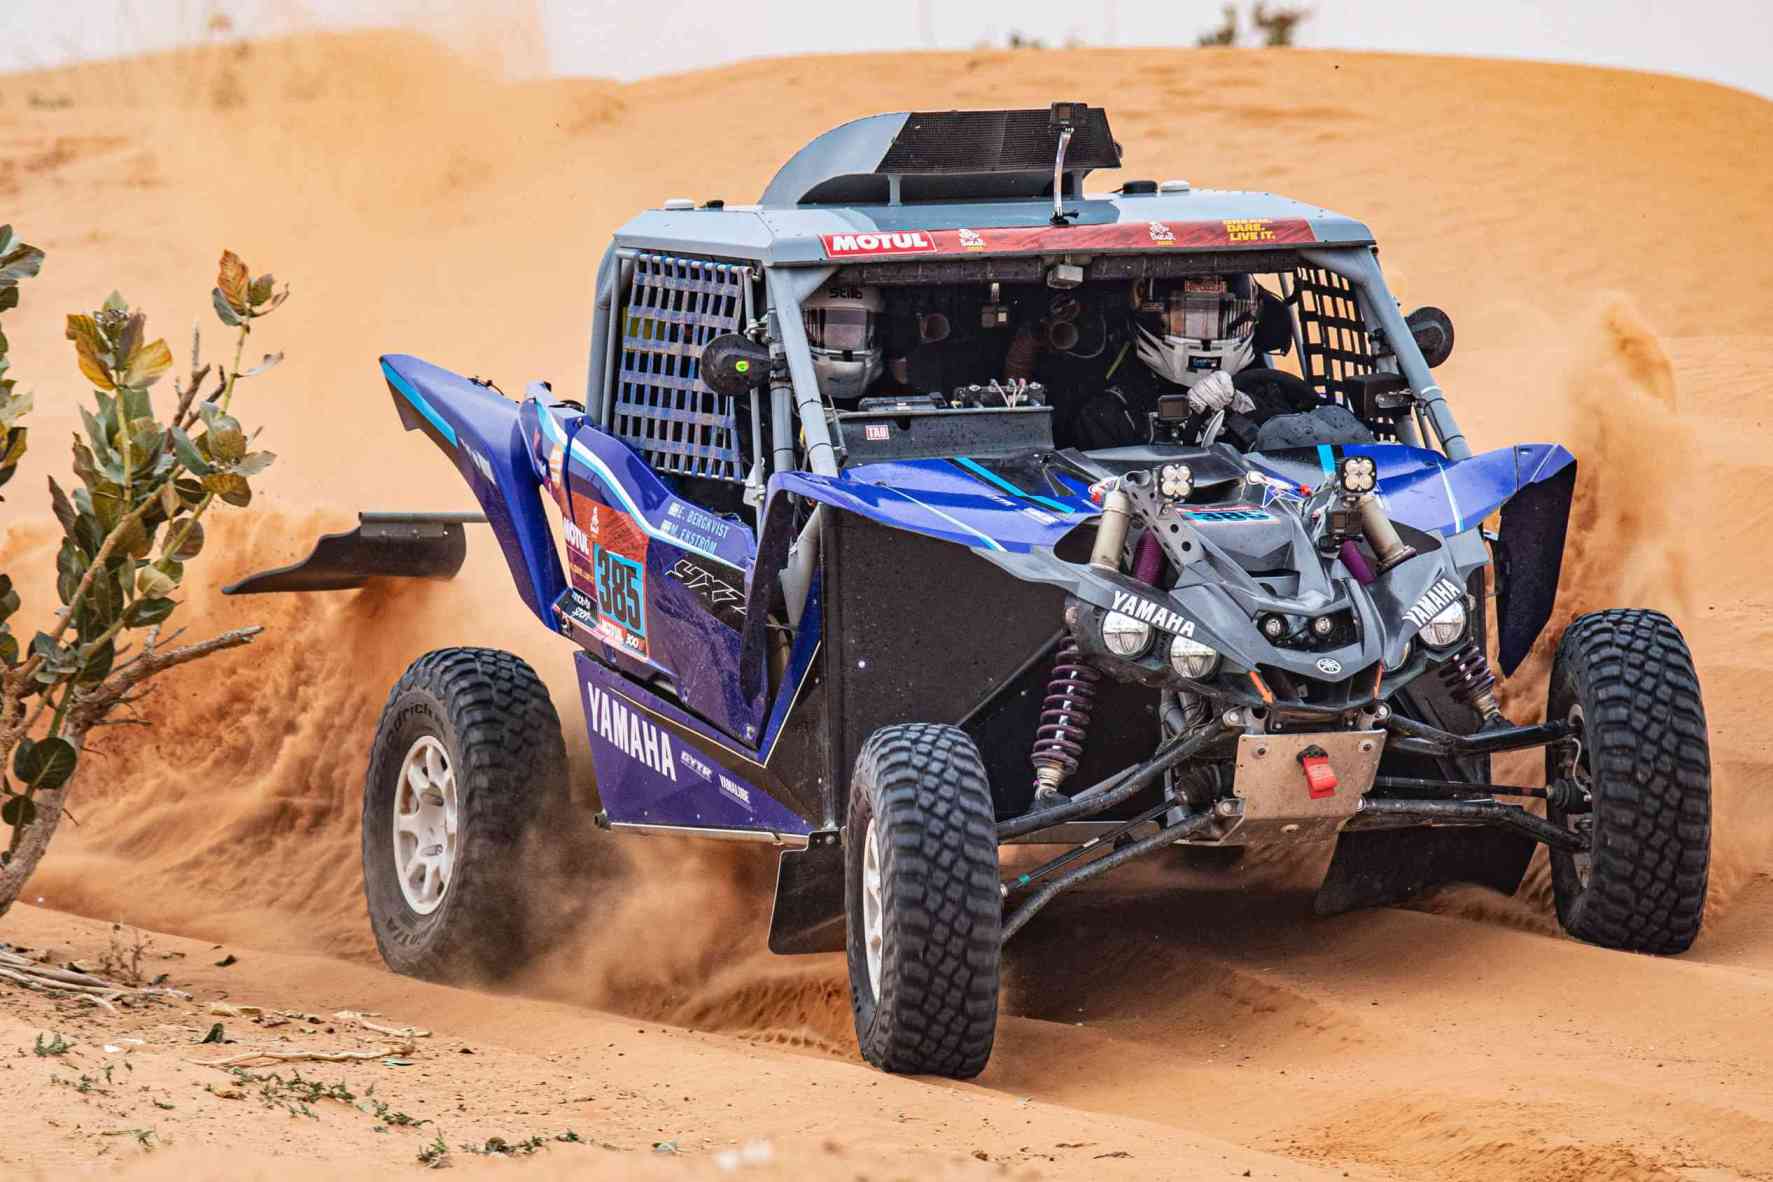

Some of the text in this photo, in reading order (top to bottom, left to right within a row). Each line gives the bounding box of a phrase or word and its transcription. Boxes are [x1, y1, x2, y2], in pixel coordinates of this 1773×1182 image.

[832, 232, 928, 250] MOTUL
[1230, 231, 1257, 241] LIVE
[599, 546, 642, 631] 385
[1403, 577, 1463, 628] YAMAHA
[1111, 590, 1196, 637] YAMAHA
[587, 680, 677, 783] YAMAHA
